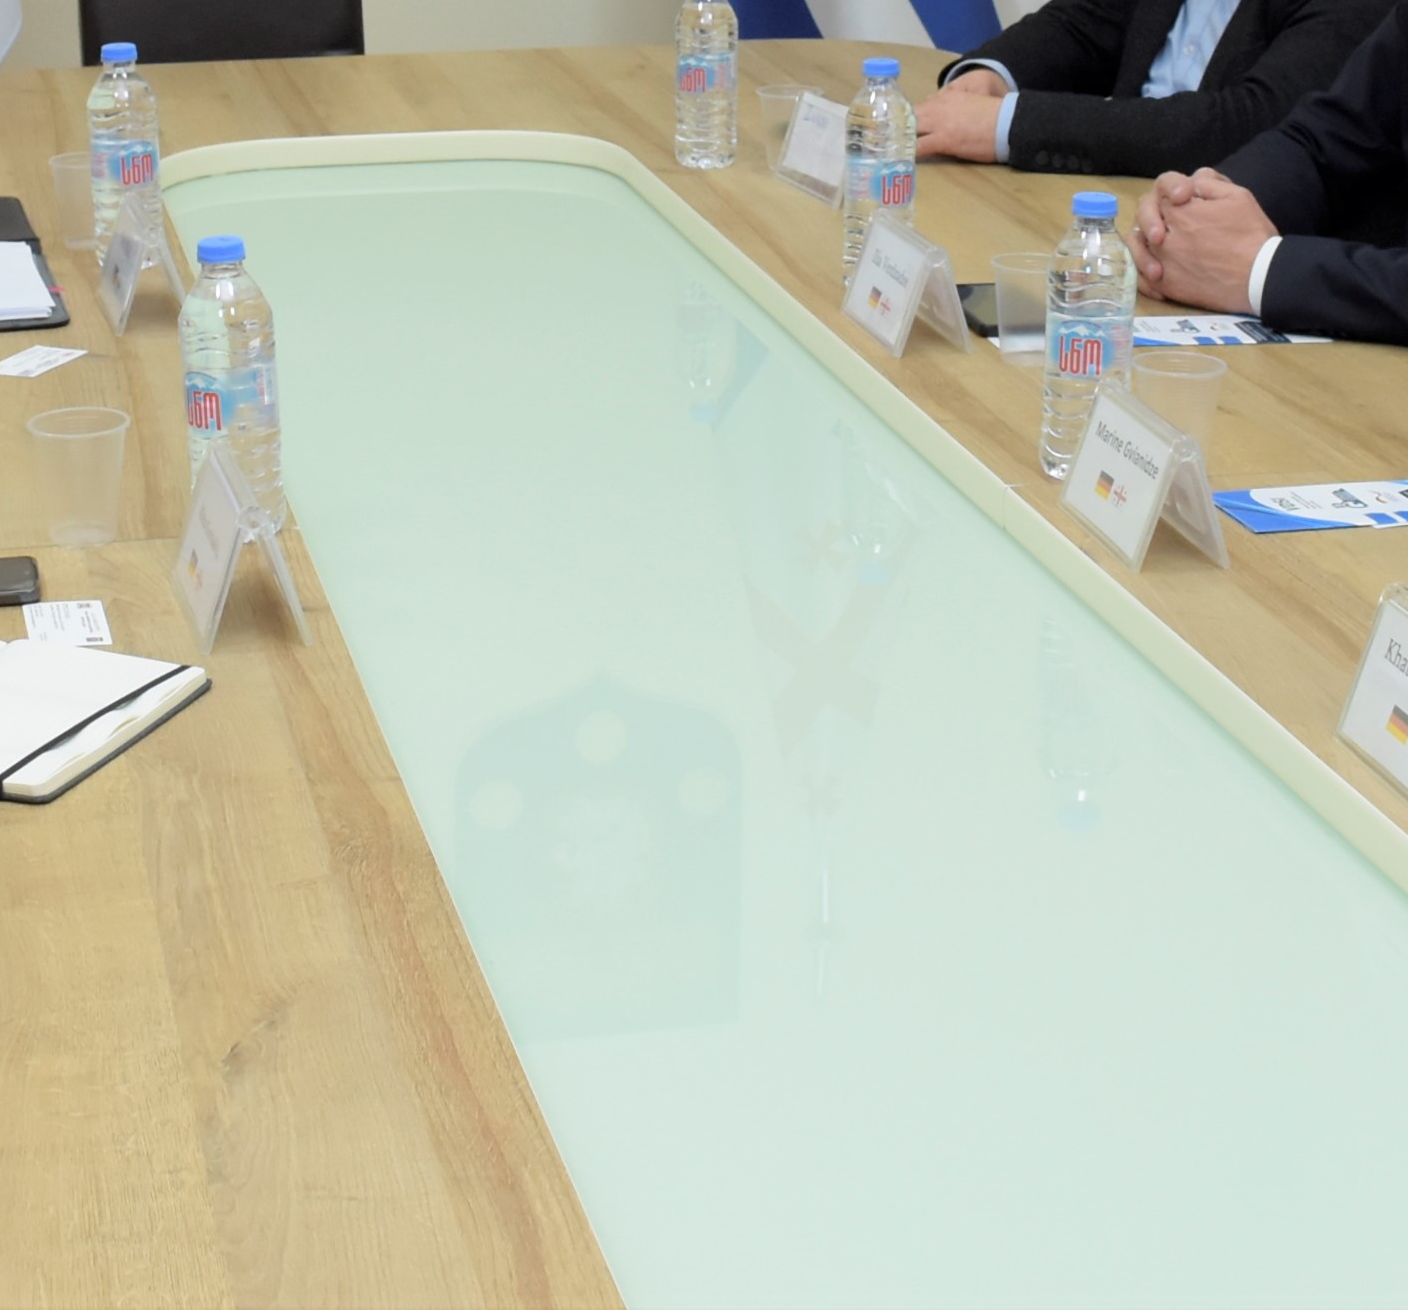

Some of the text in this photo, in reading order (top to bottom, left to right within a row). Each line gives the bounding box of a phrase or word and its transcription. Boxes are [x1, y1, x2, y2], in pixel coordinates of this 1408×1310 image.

[120, 153, 154, 186] სნო
[1059, 335, 1102, 376] სნო
[1095, 420, 1124, 453] Marine
